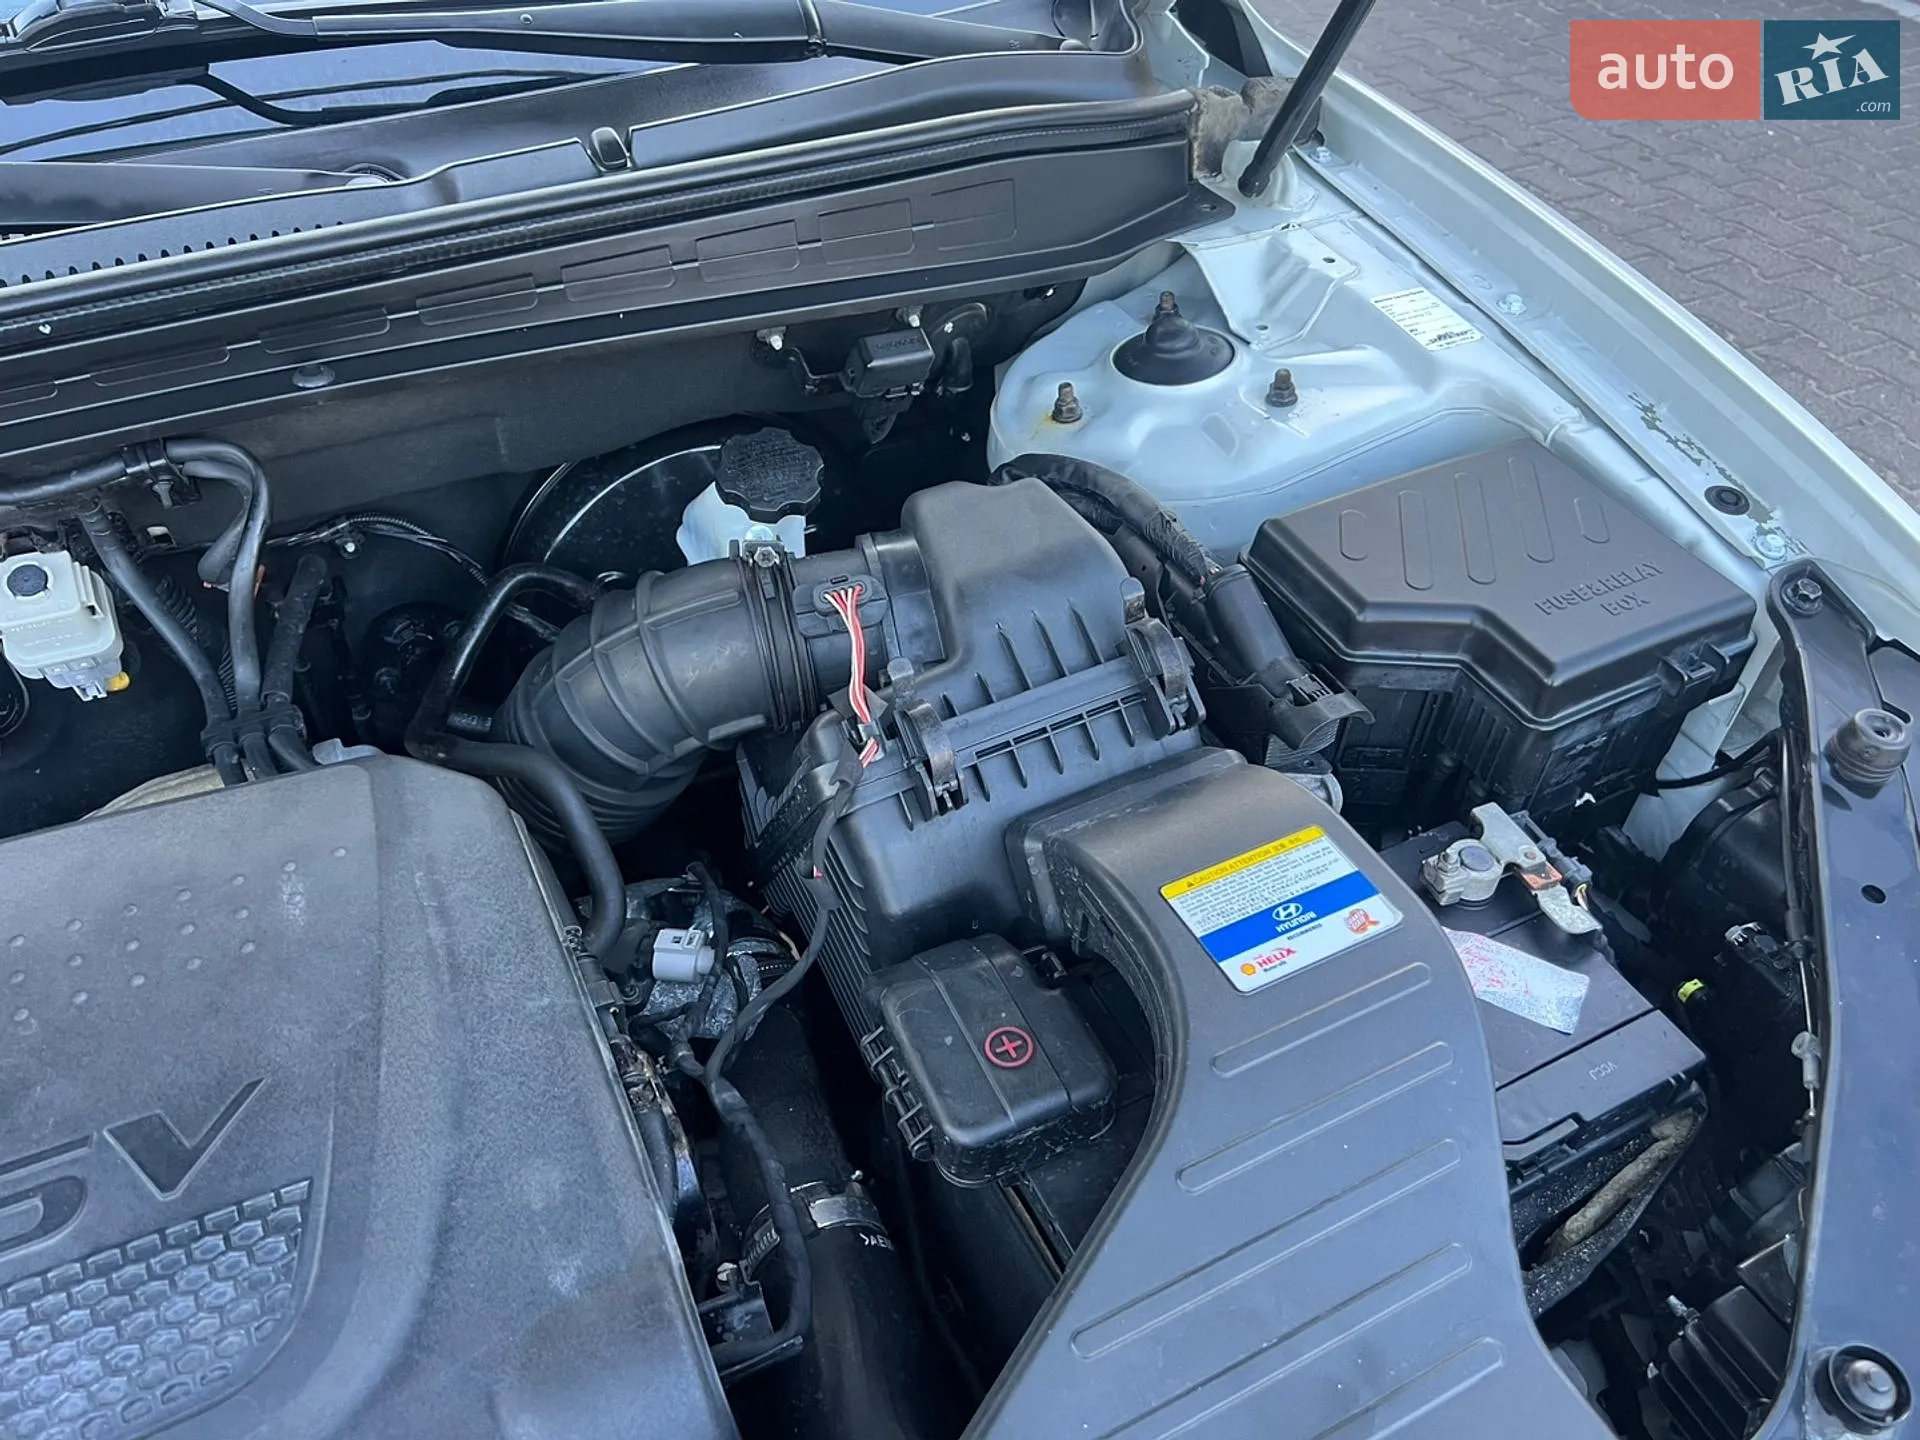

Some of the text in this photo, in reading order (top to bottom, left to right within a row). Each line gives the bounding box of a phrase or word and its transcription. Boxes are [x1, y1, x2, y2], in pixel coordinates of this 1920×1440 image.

[1600, 591, 1651, 617] BOX
[1193, 864, 1229, 886] CAUTION
[1275, 910, 1318, 933] HYUNDAI
[1256, 947, 1297, 969] HELIX
